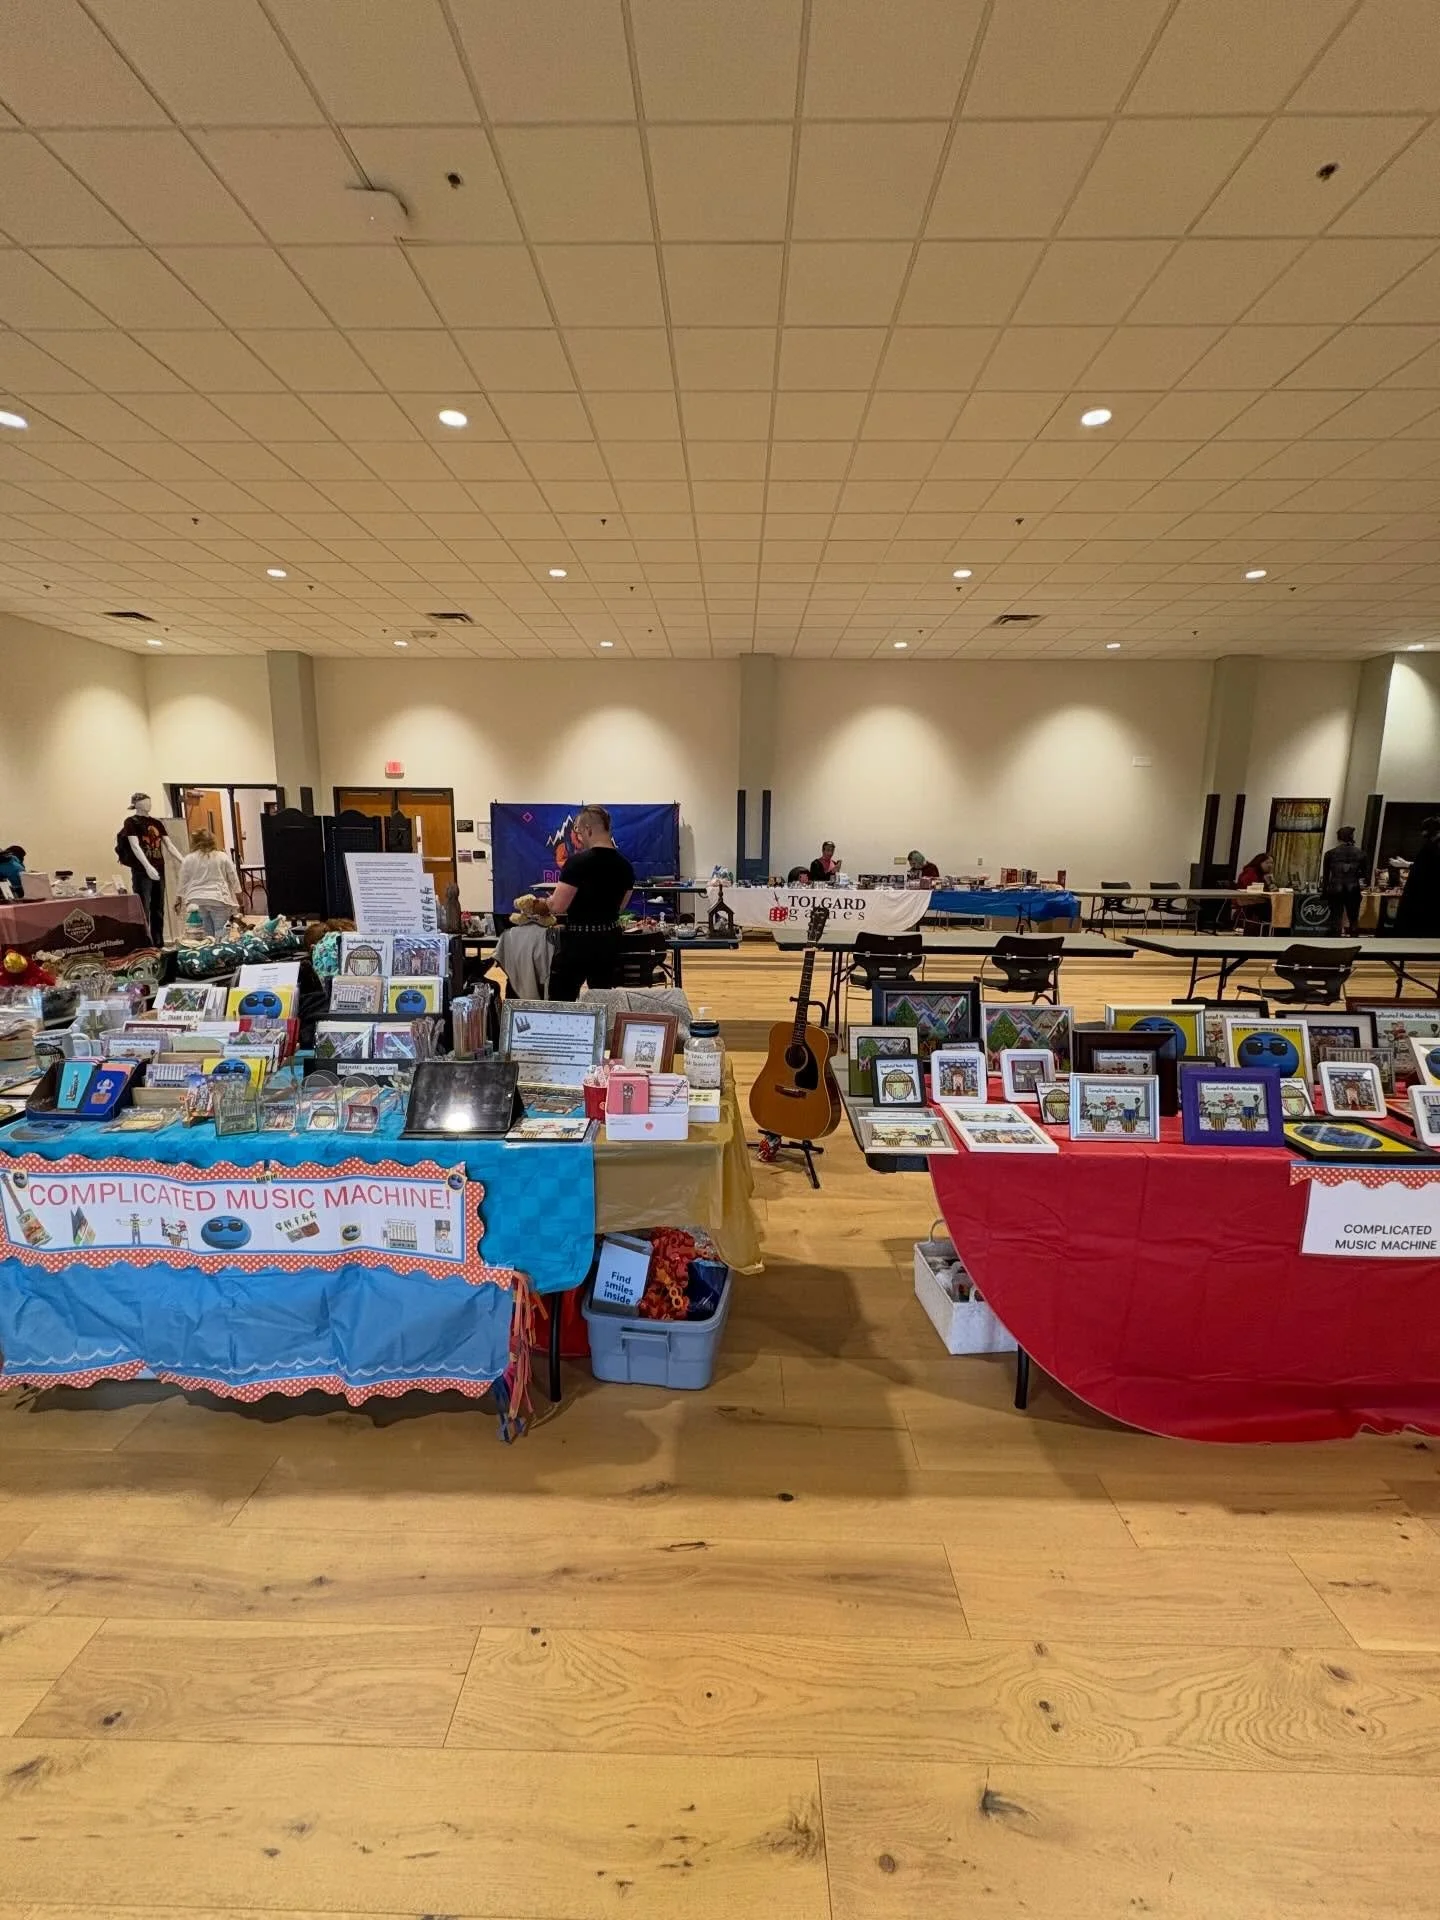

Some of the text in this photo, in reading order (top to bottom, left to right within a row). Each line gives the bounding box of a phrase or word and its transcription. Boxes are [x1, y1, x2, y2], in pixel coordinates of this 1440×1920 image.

[788, 895, 866, 910] TOLGARD
[29, 1182, 452, 1212] COMPLICATED MUSIC MACHINE!
[1343, 1223, 1432, 1235] COMPLICATED
[1334, 1239, 1438, 1250] MUSIC MACHINE
[611, 1271, 632, 1284] Find
[604, 1281, 634, 1296] smiles
[603, 1289, 631, 1305] inside
